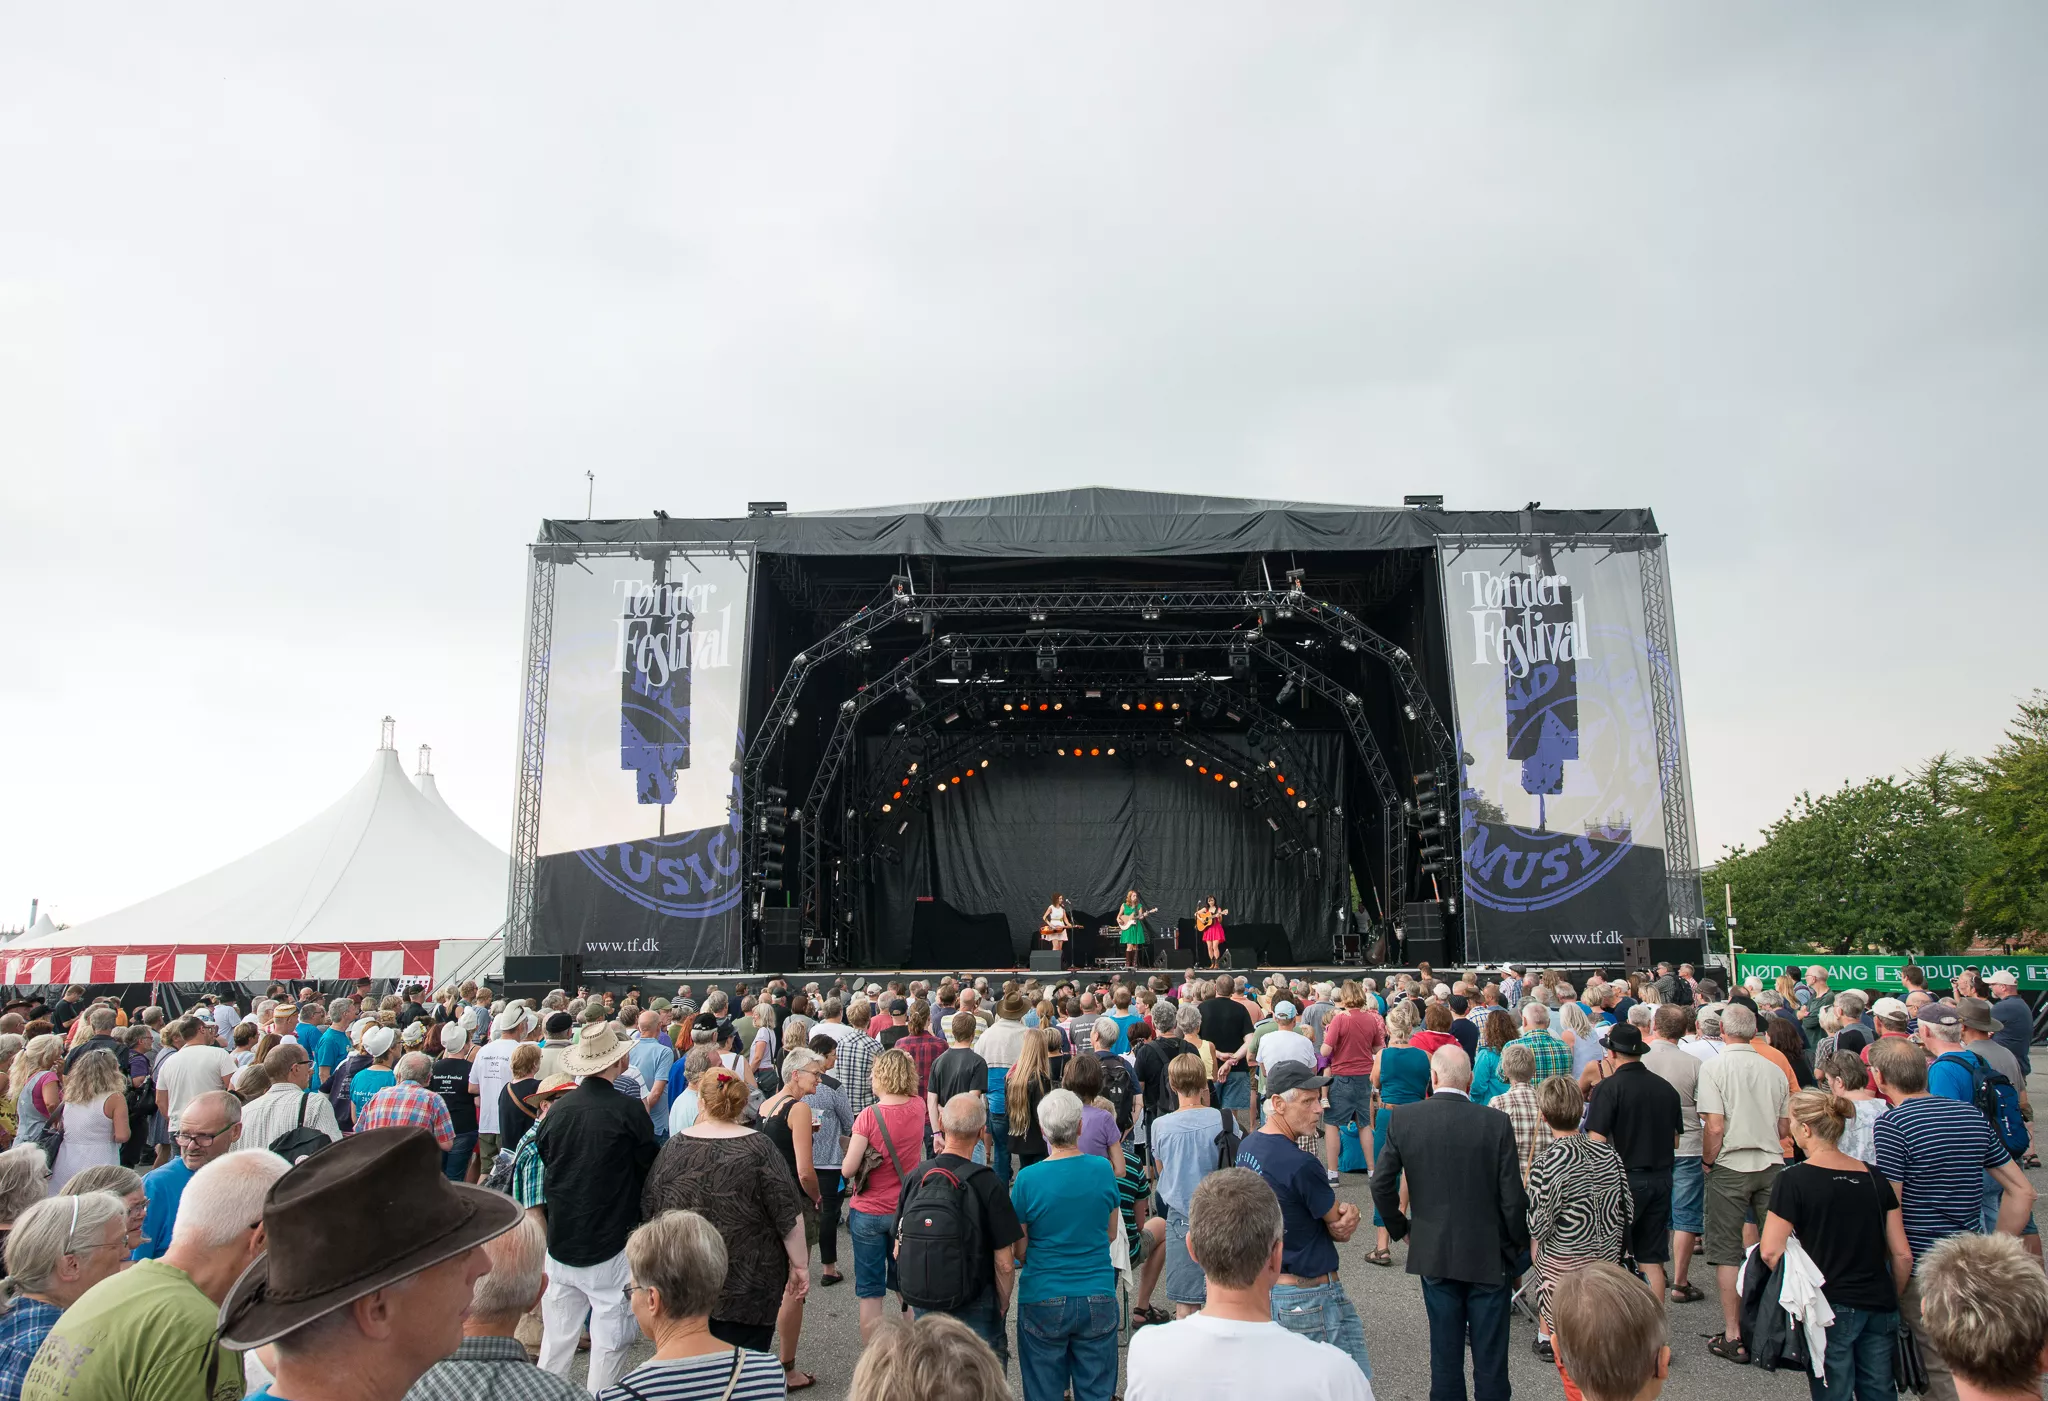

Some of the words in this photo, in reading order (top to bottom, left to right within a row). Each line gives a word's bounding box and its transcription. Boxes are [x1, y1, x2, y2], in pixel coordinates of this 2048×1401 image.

[612, 572, 717, 618] Tønder
[1462, 564, 1568, 609] Tønder
[610, 602, 732, 696] Festival
[1467, 593, 1592, 687] Festival
[586, 938, 660, 952] www.tf.dk
[1549, 930, 1624, 944] www.tf.dk
